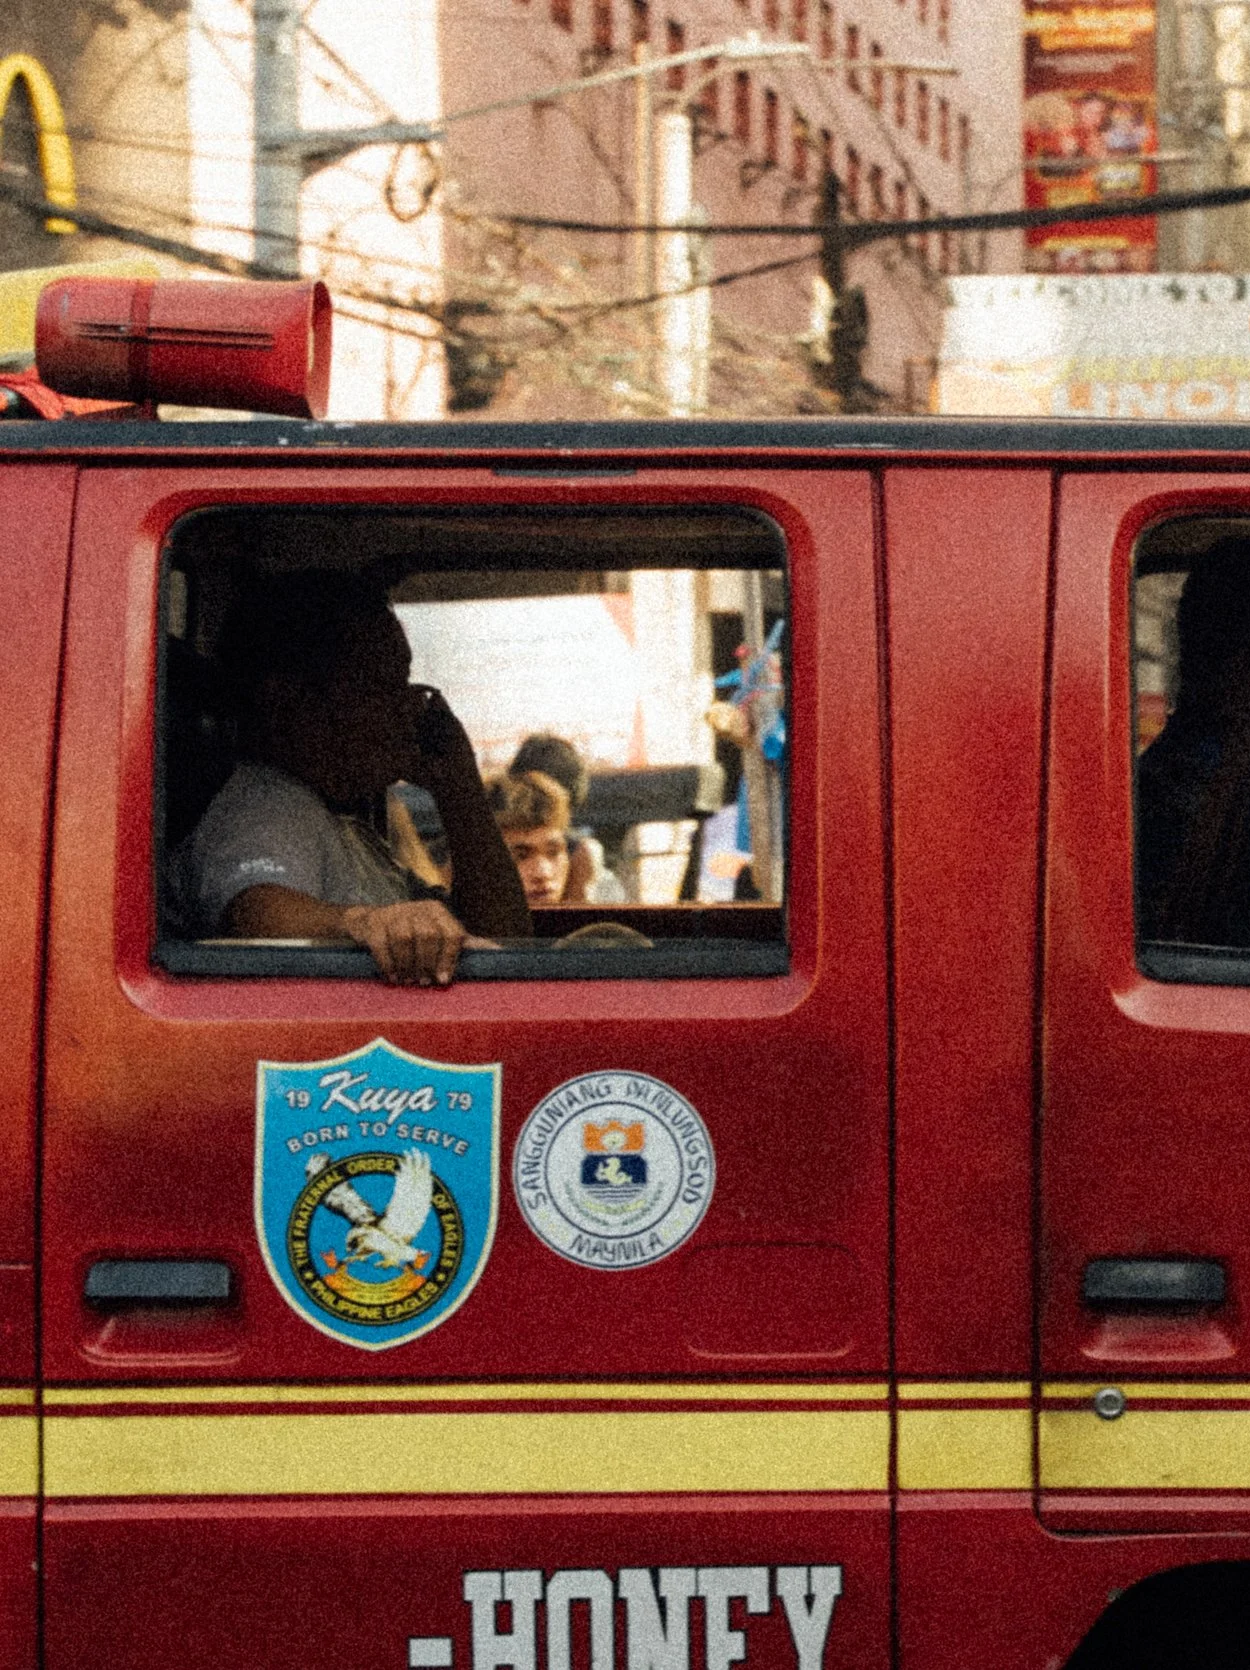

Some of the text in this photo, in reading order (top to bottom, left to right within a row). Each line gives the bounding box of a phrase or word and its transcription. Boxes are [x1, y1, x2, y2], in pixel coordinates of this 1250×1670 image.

[286, 1069, 473, 1126] 19 Kuya 79
[286, 1121, 471, 1157] BORN TO SERVE
[521, 1076, 612, 1211] SANGGUNIANG
[291, 1158, 461, 1269] THE FRATERNAL ORDER OF EAGLES
[570, 1232, 665, 1262] MAYNILA
[310, 1281, 440, 1320] PHILIPPINE EAGLES
